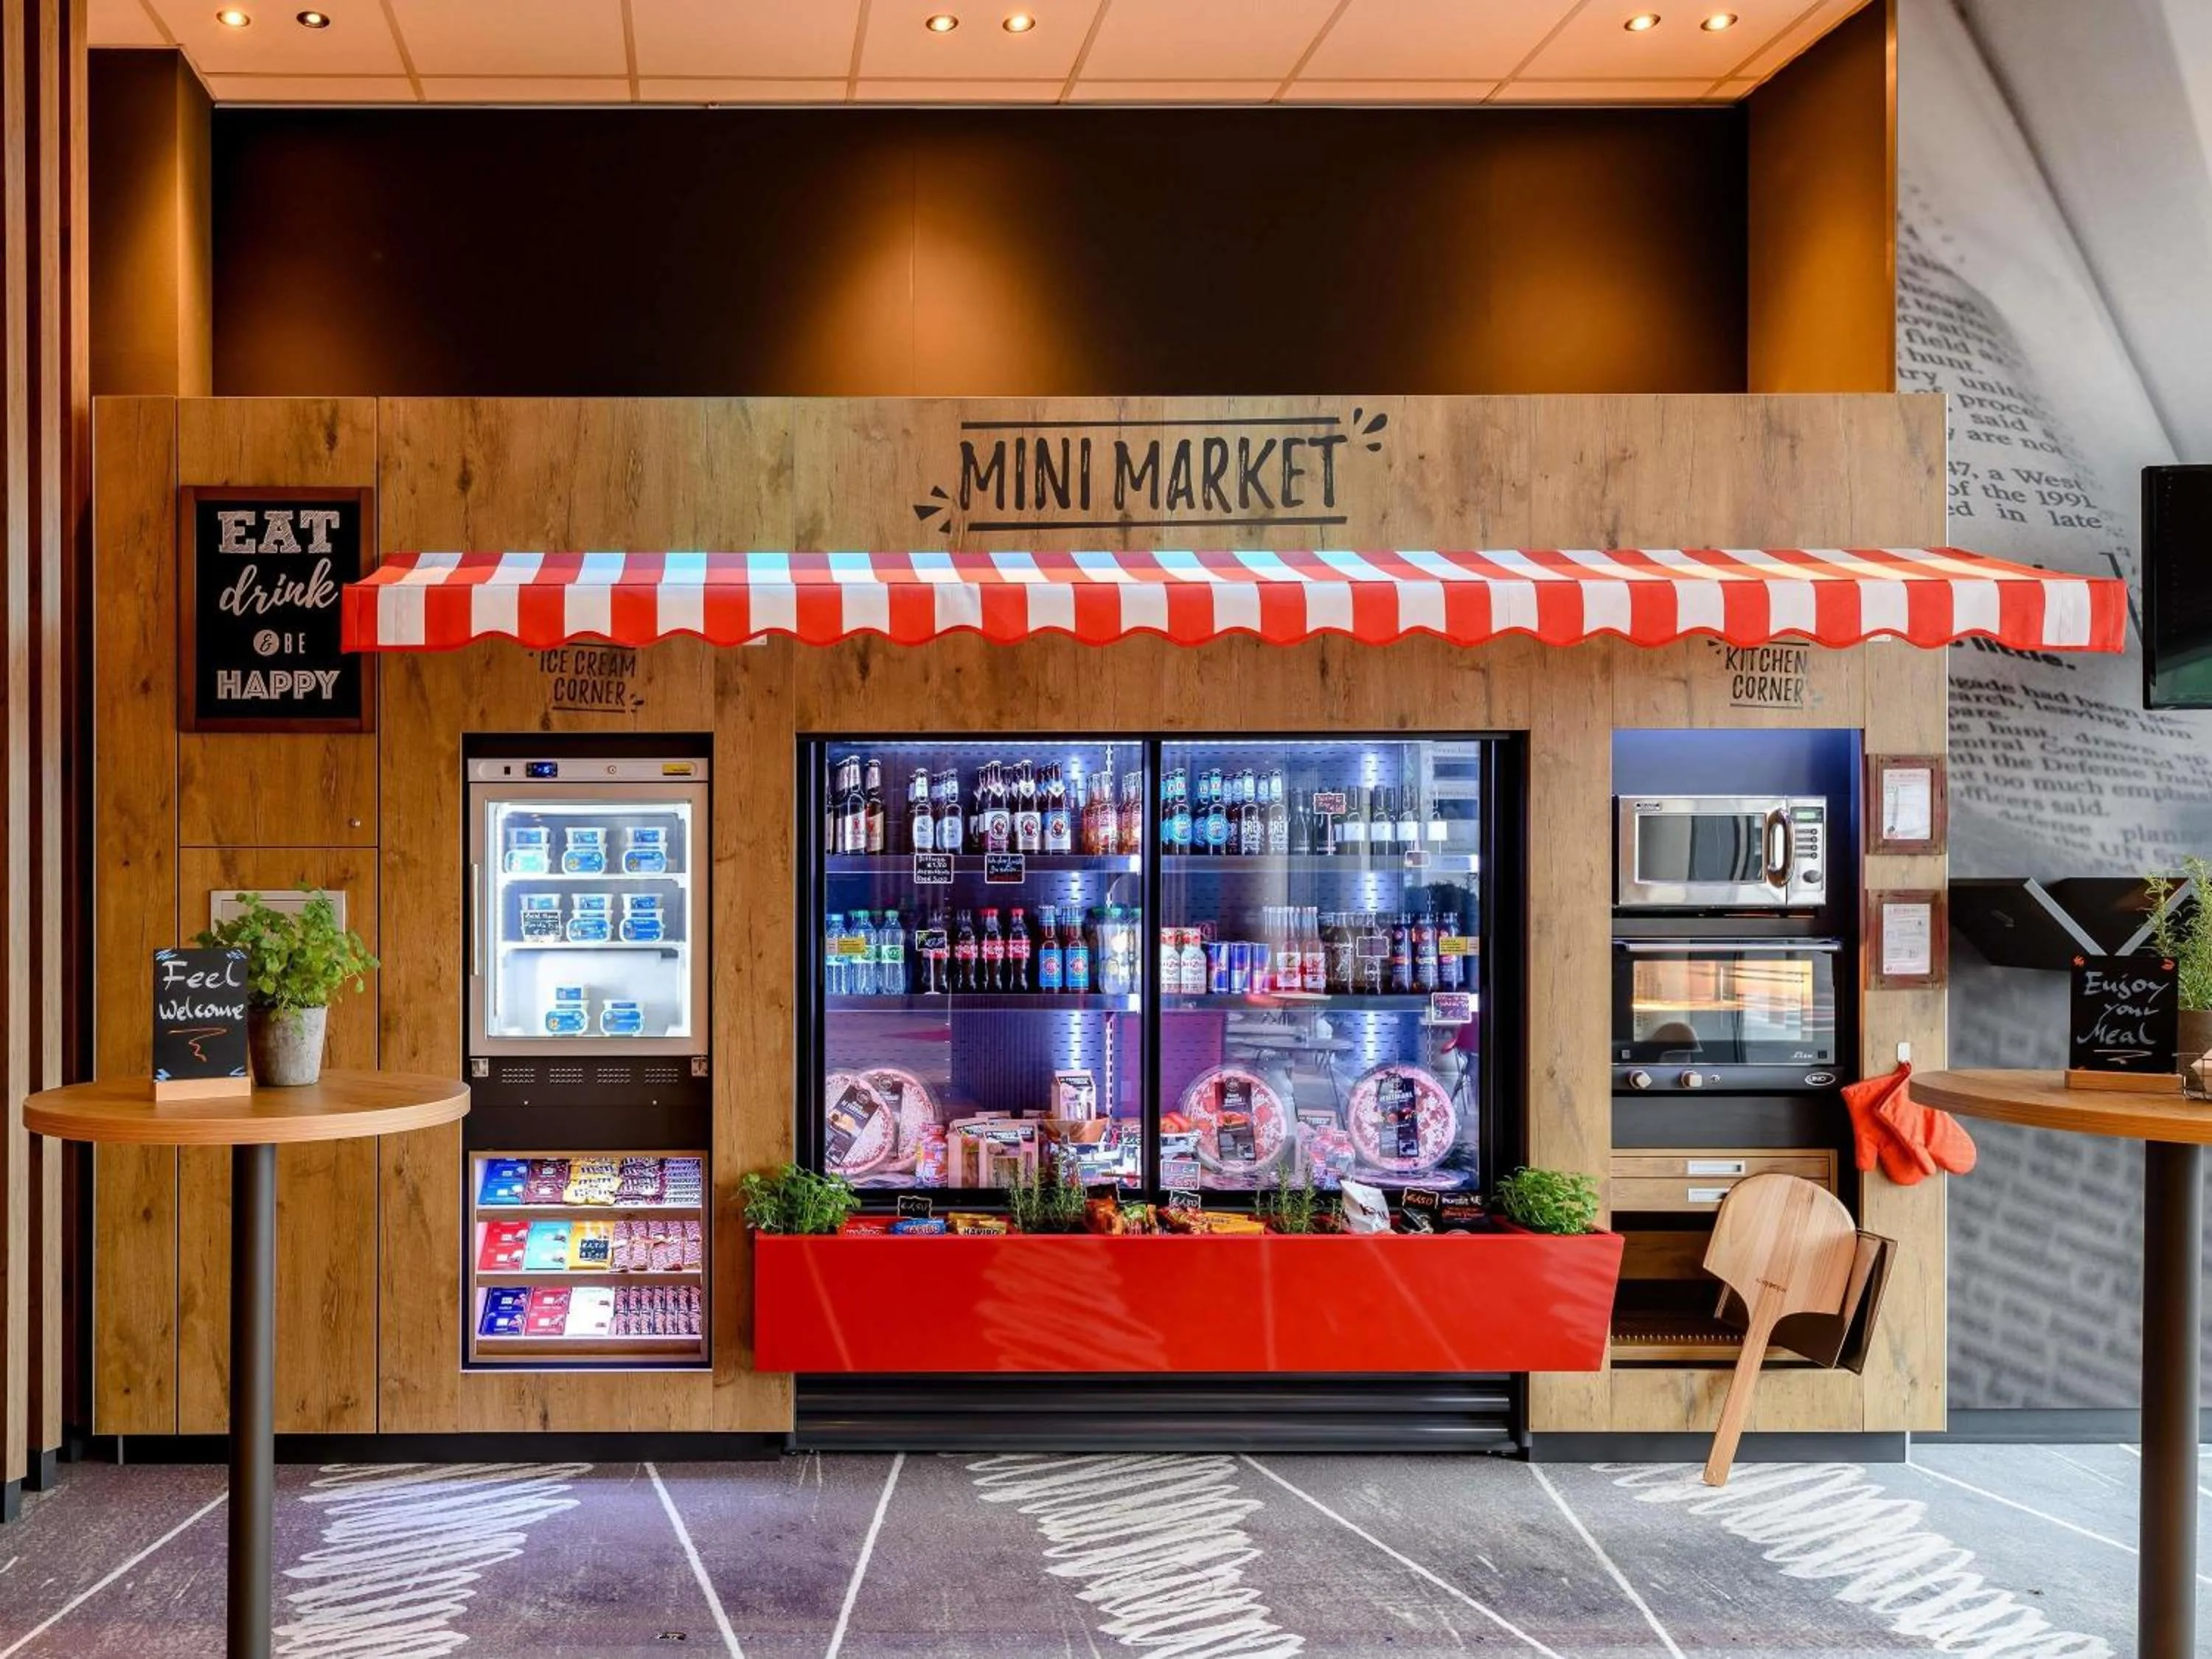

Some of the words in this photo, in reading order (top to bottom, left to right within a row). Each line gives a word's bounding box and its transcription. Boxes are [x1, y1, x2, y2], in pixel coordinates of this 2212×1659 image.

[1905, 328, 1971, 355] field
[1969, 412, 2028, 432] said
[1967, 428, 2012, 445] are
[959, 437, 1091, 511] MINI
[1114, 434, 1349, 514] MARKET
[1989, 468, 2005, 481] a
[2011, 467, 2085, 492] West
[1981, 483, 2028, 504] the
[2035, 490, 2098, 509] 1991
[1995, 503, 2028, 523] in
[2048, 509, 2103, 529] late
[218, 510, 340, 553] EAT
[220, 557, 338, 616] drink
[284, 632, 306, 653] BE
[540, 648, 569, 673] ICE
[575, 650, 636, 678] CREAM
[1725, 646, 1809, 675] KITCHEN
[217, 669, 341, 700] HAPPY
[554, 677, 626, 706] CORNER
[1733, 675, 1804, 703] CORNER
[1992, 753, 2033, 770] the
[2033, 776, 2104, 796] much
[161, 961, 242, 991] Feel
[2084, 971, 2170, 1004] Enjoy
[2076, 1023, 2157, 1045] Meal
